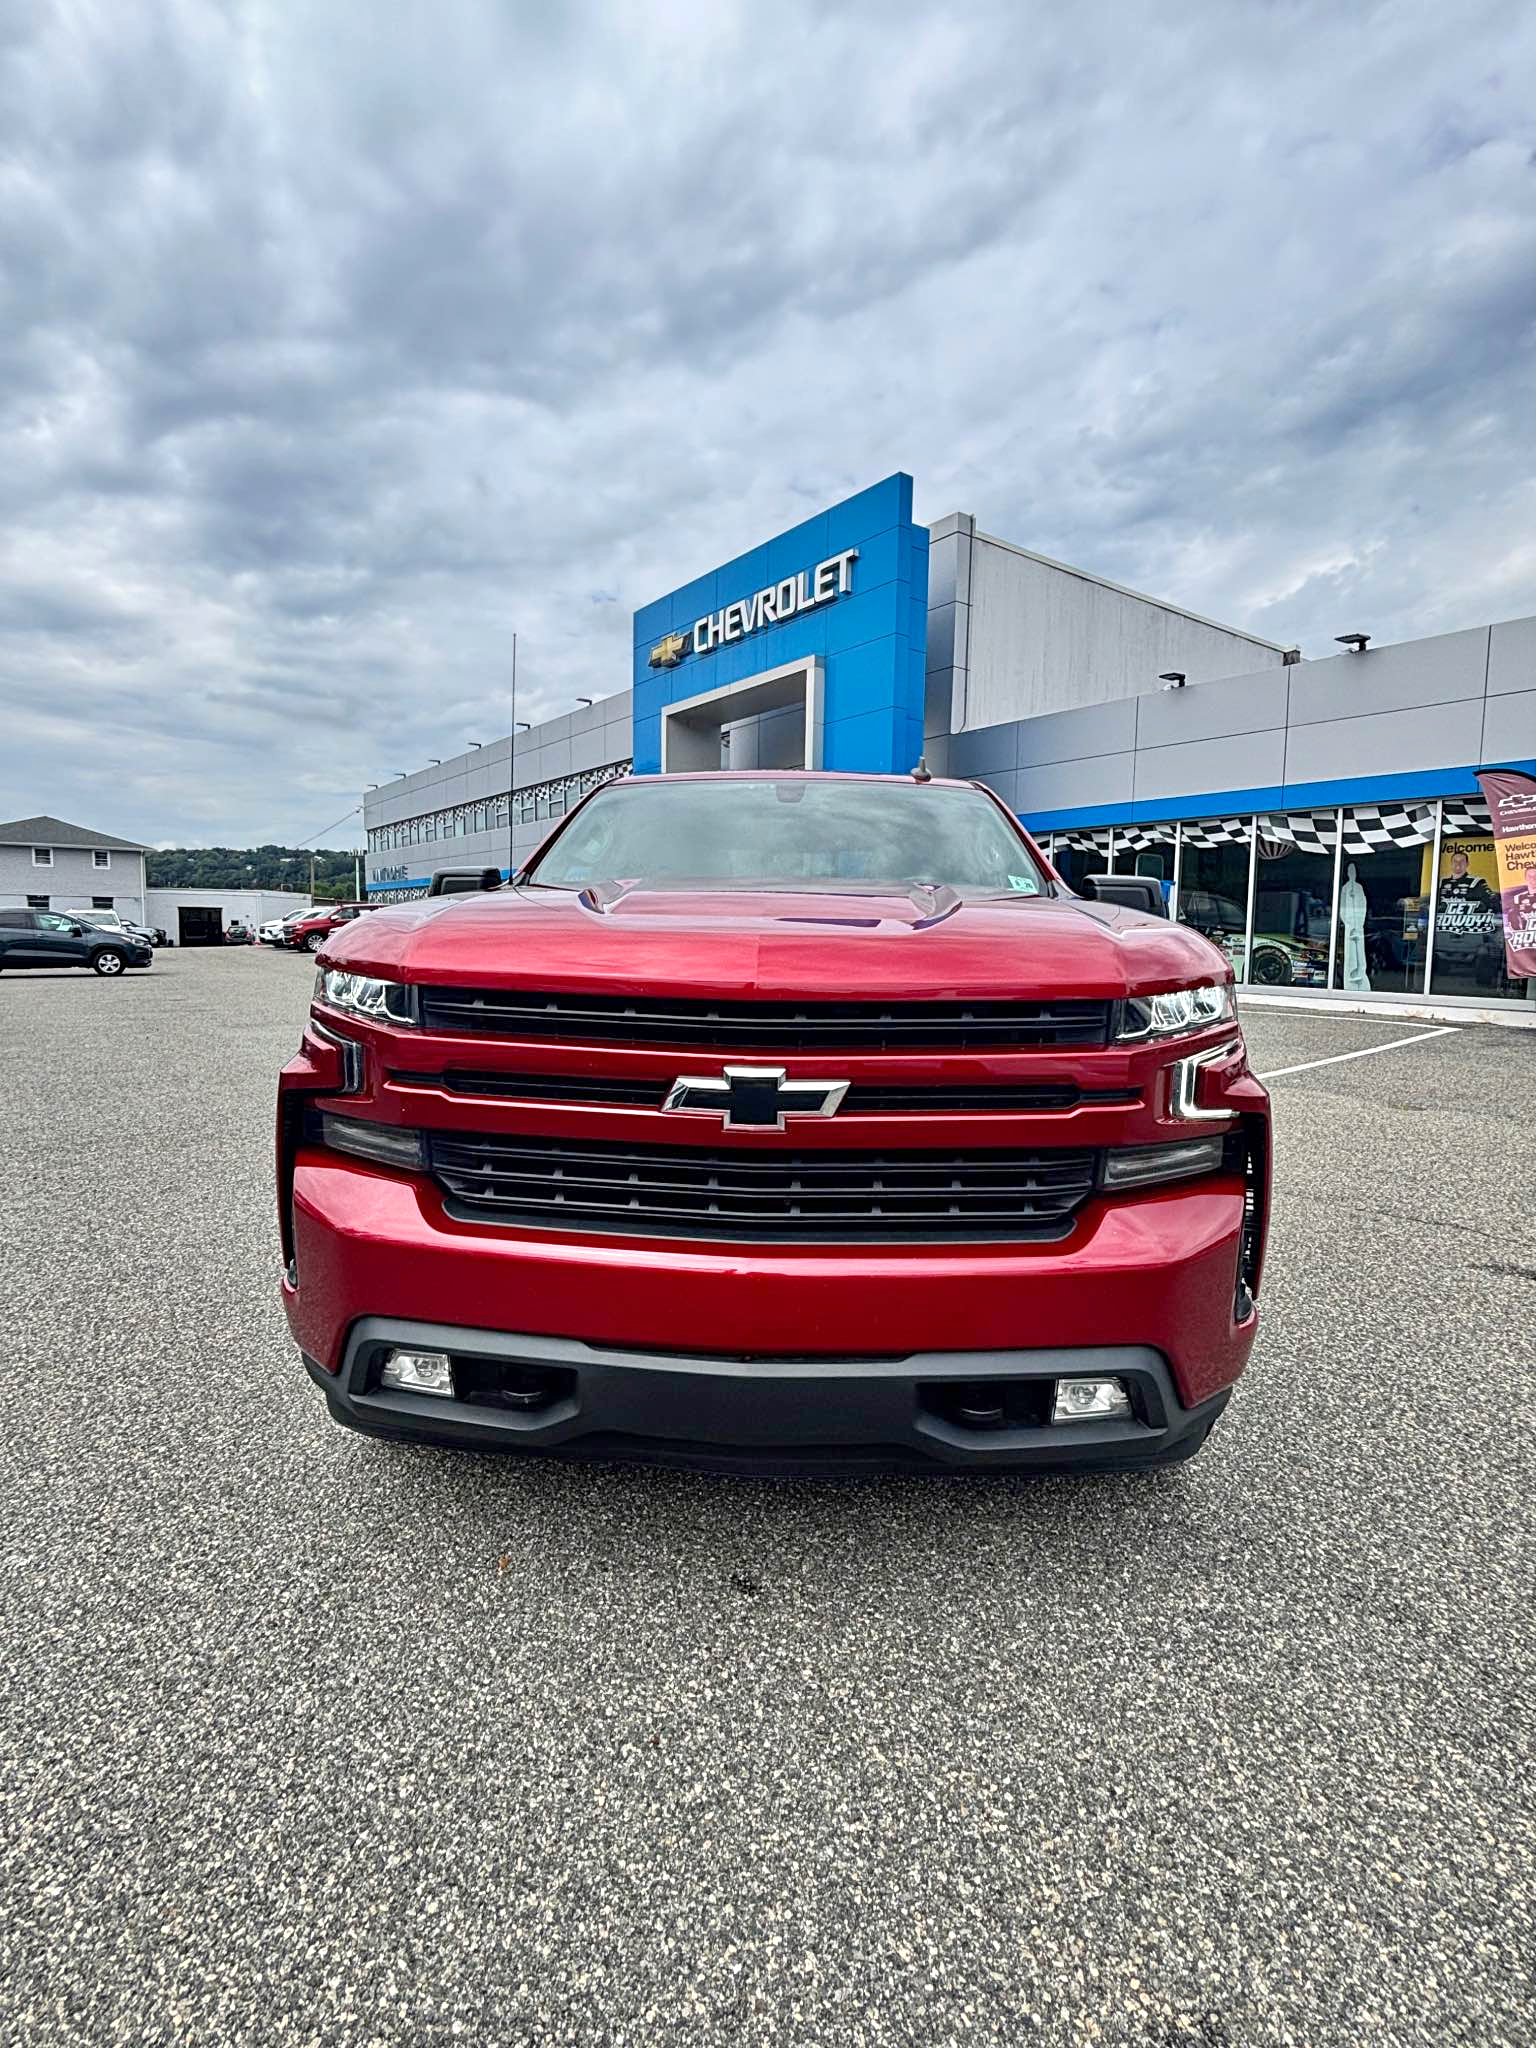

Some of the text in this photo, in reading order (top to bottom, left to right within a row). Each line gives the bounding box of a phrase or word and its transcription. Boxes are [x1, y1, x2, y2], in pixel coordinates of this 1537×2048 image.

[693, 548, 859, 654] CHEVROLET
[1505, 850, 1536, 861] Hawt
[1447, 903, 1477, 915] GET
